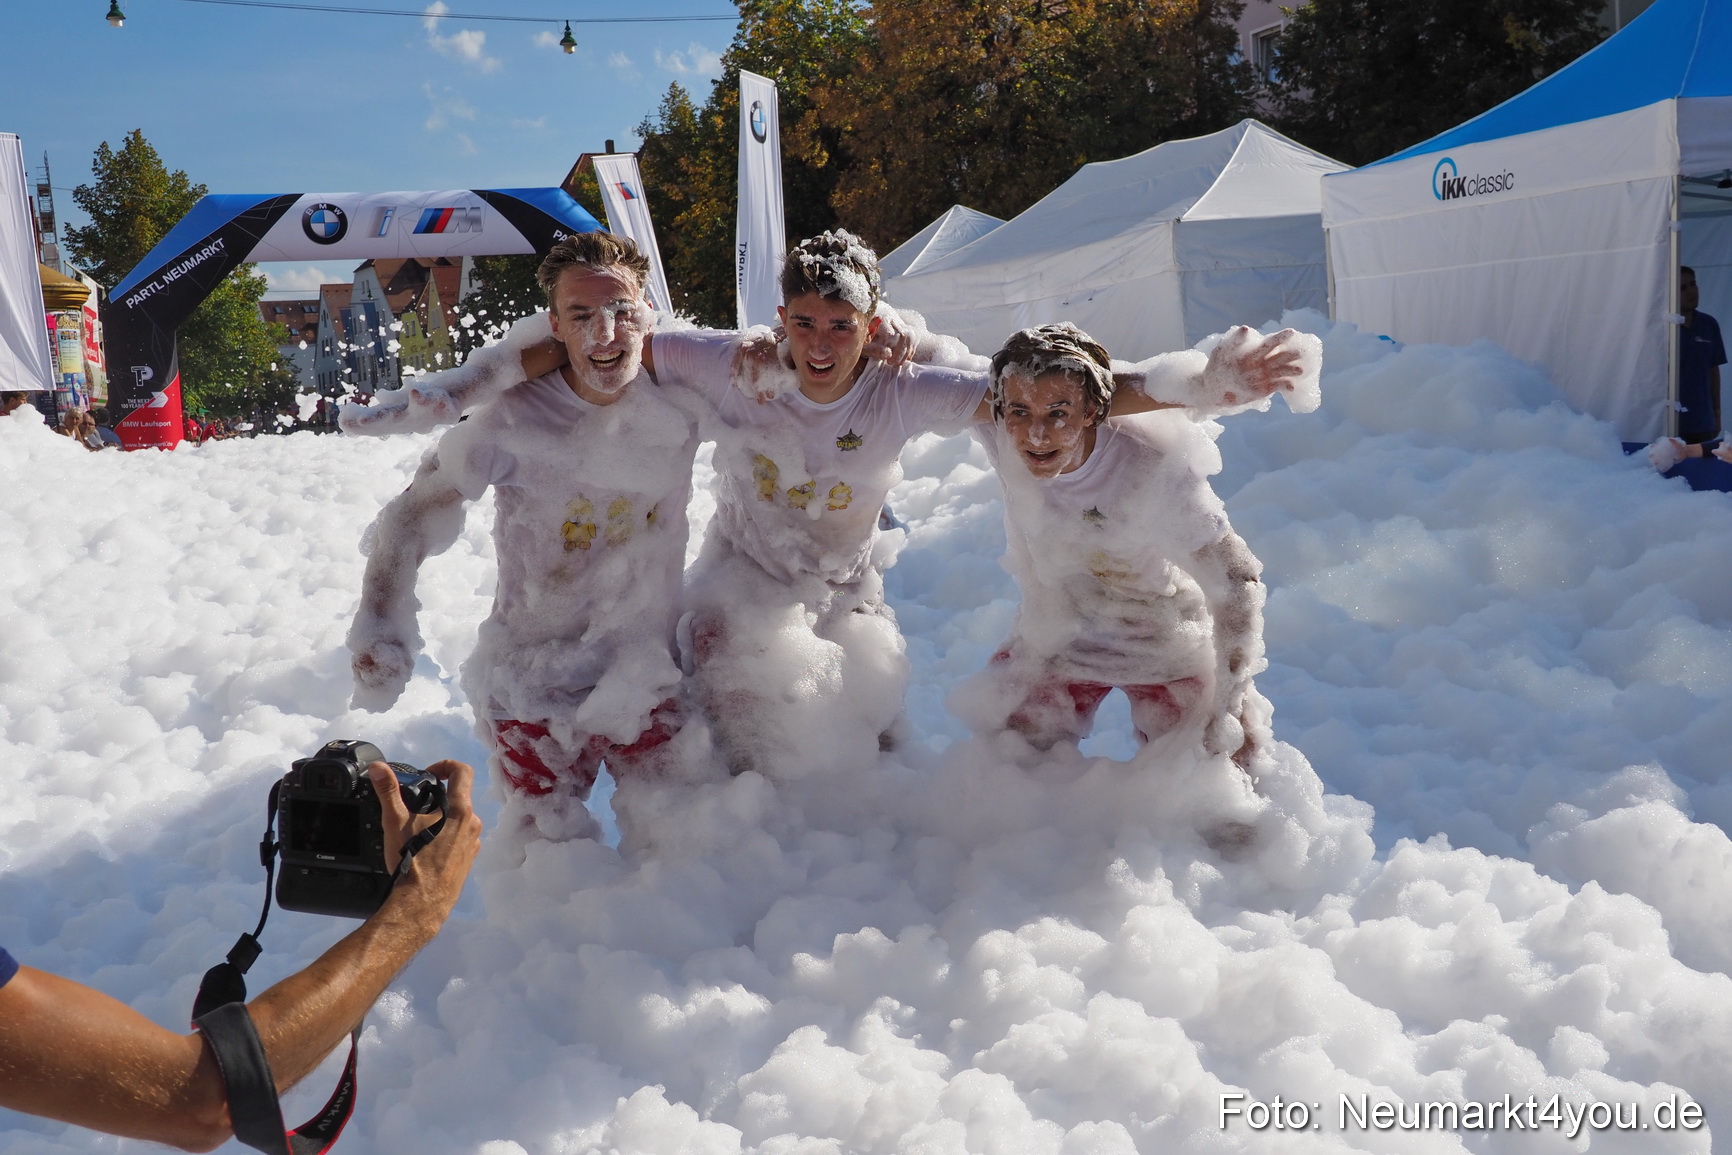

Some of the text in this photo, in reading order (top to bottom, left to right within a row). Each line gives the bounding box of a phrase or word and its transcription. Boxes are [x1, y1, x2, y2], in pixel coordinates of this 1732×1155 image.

[1468, 169, 1514, 196] classic
[305, 203, 342, 216] BMW
[126, 237, 225, 309] PARTL NEUMARKT
[140, 420, 172, 428] Laufsport
[316, 853, 336, 861] Canon
[330, 1081, 351, 1117] Mark
